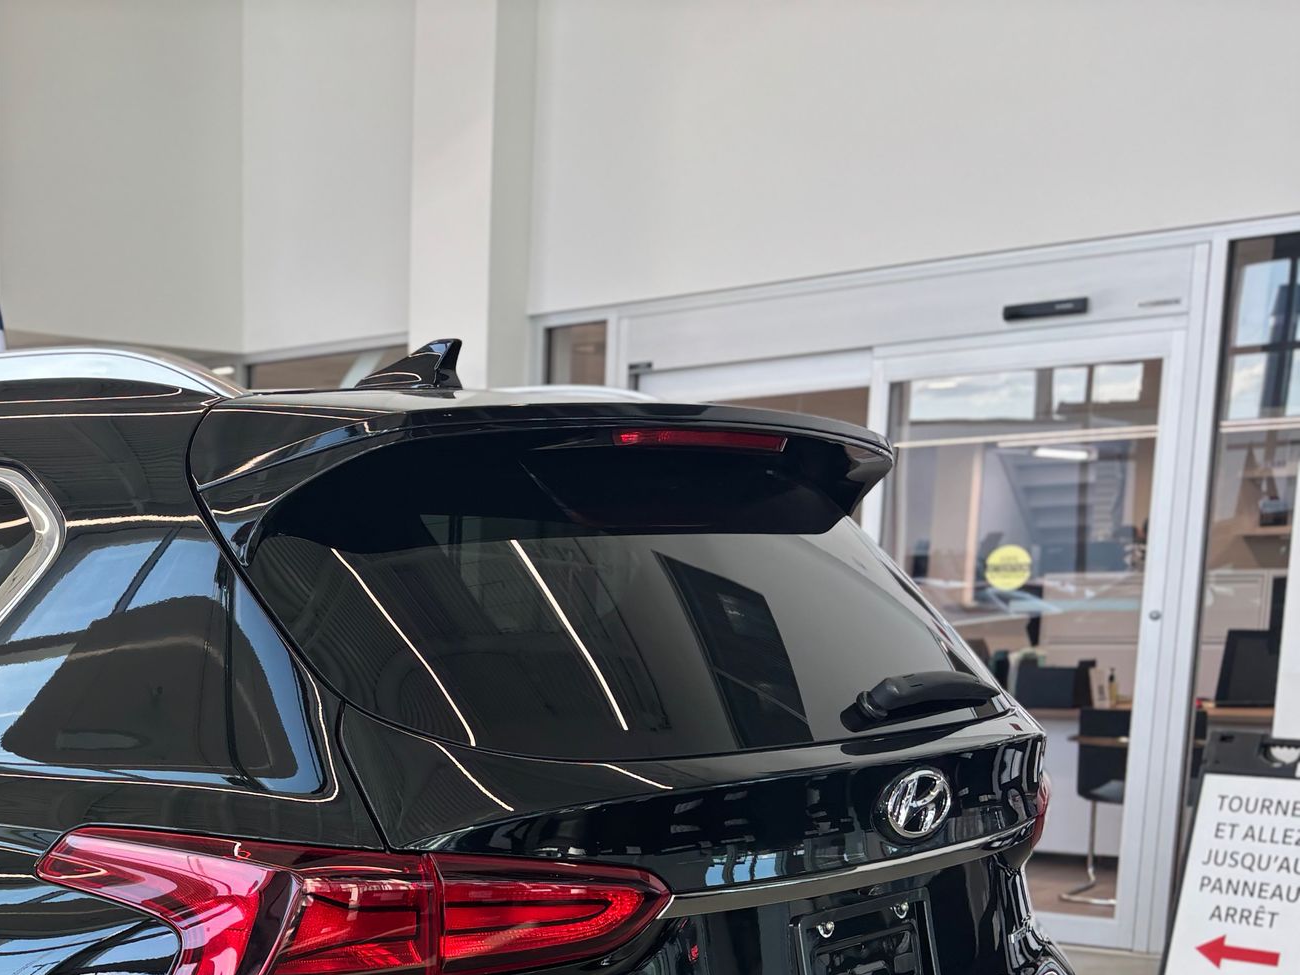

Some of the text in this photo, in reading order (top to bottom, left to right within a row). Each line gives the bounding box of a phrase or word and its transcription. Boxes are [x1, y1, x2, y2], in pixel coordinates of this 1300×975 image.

[1217, 794, 1300, 818] TOURNE
[1214, 822, 1239, 840] ET
[1199, 876, 1300, 904] PANNEAU
[1209, 905, 1279, 929] ARRÊT
